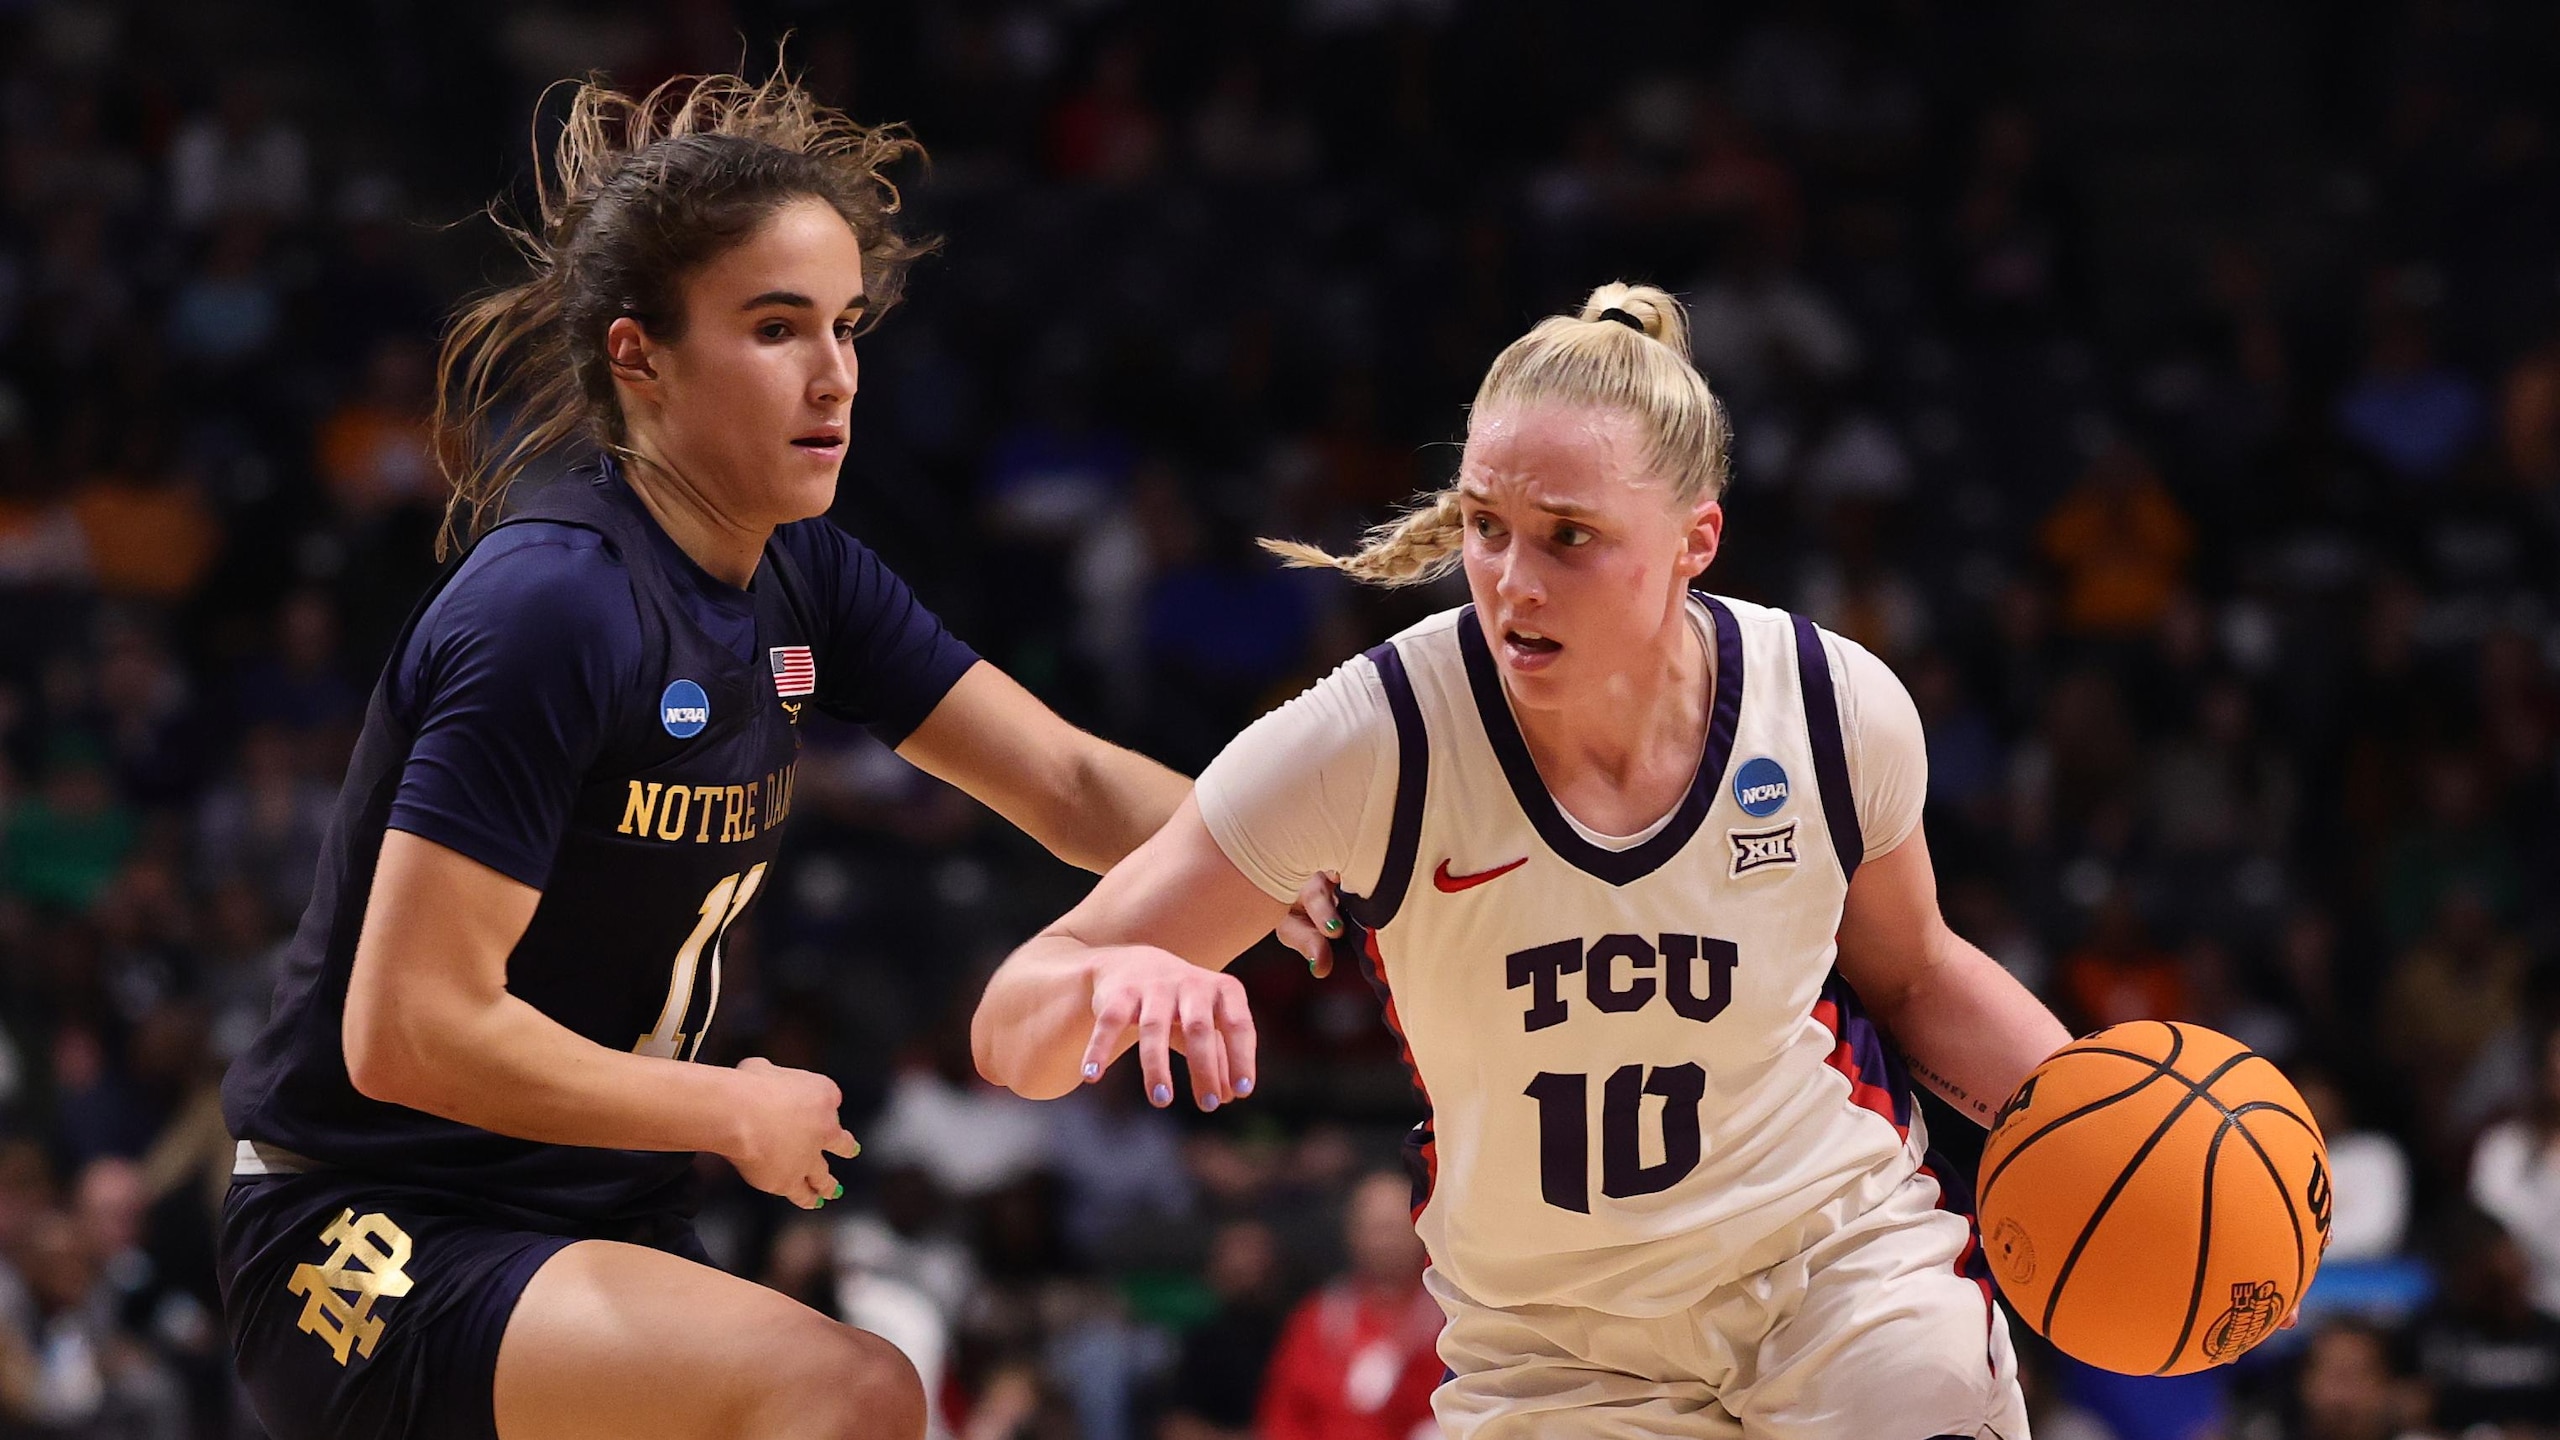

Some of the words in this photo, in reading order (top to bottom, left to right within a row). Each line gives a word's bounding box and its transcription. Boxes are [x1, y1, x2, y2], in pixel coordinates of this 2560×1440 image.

[666, 707, 706, 723] NCAA
[617, 780, 759, 843] NOTRE
[763, 758, 800, 832] DAM
[1742, 782, 1787, 805] NCAA
[1733, 826, 1795, 871] XII
[631, 861, 768, 1063] 11
[1505, 932, 1739, 1033] TCU
[1522, 1061, 1707, 1215] 10
